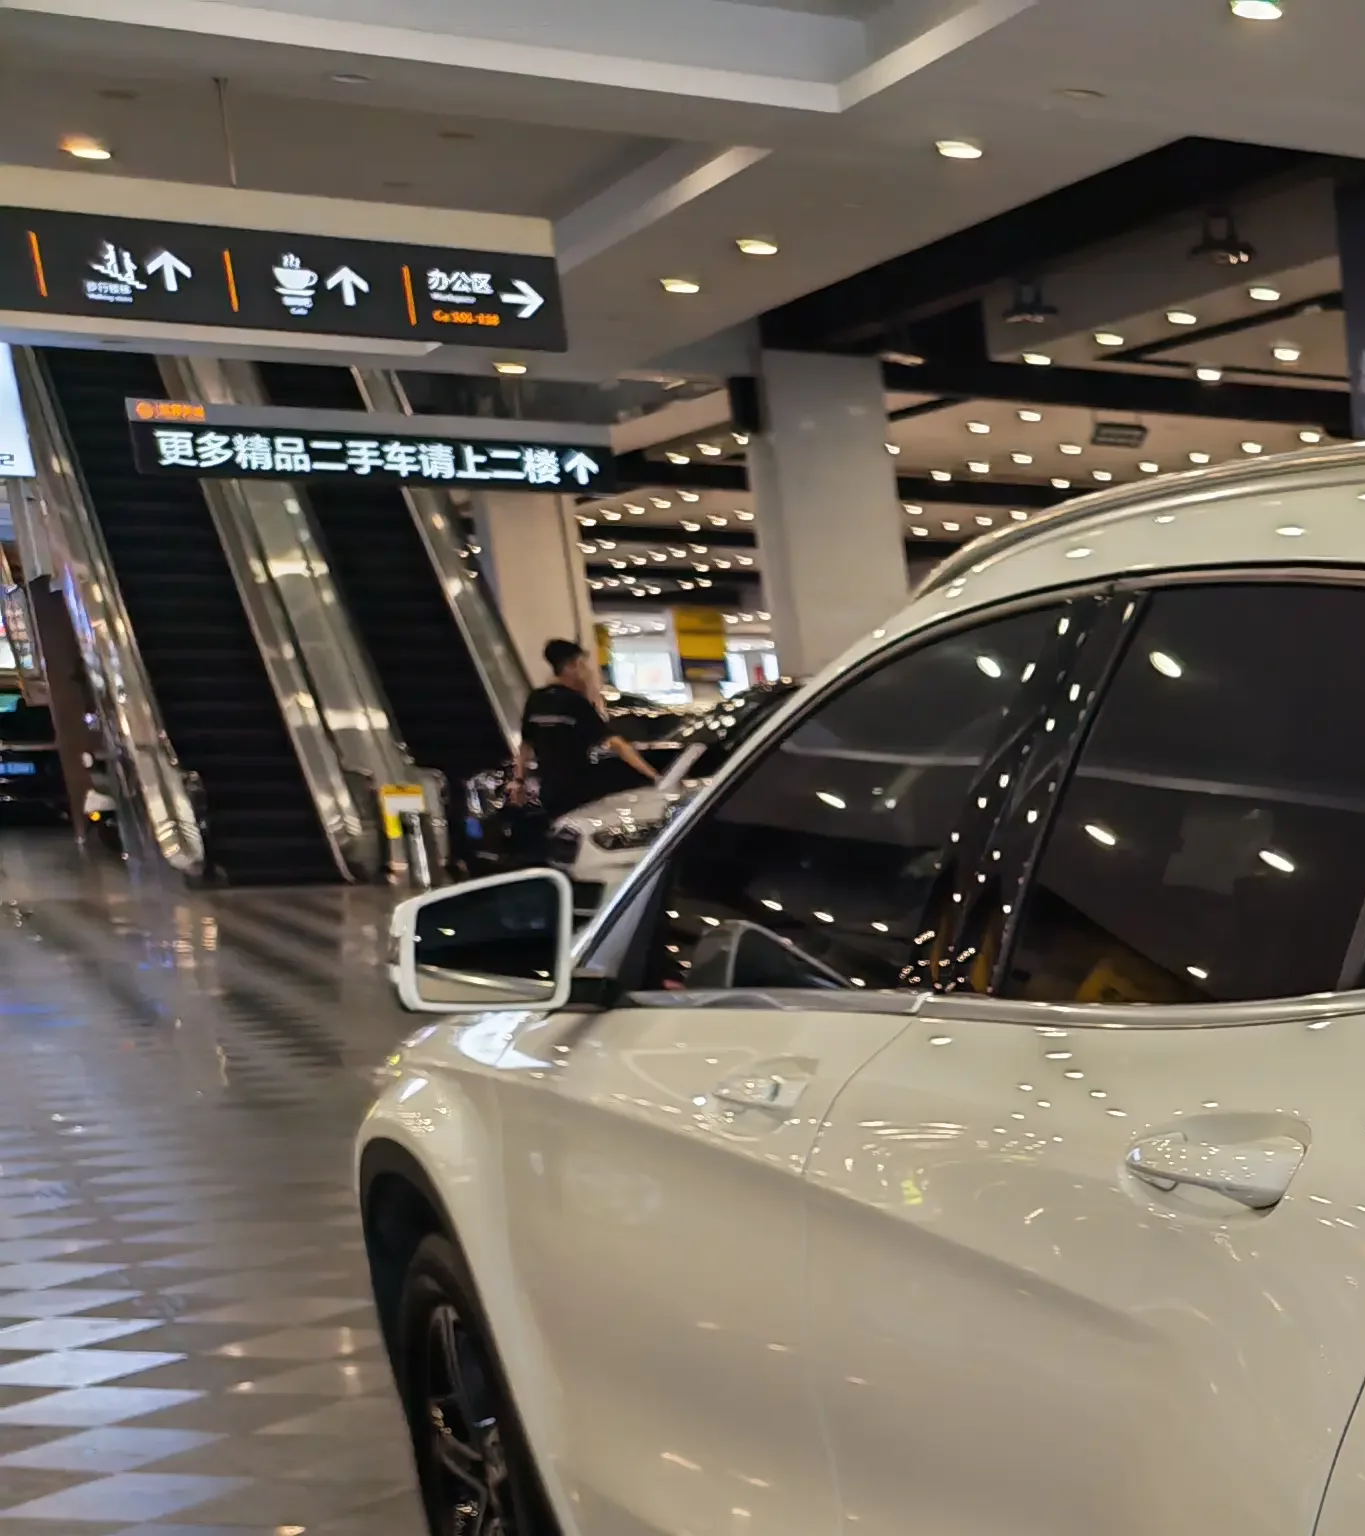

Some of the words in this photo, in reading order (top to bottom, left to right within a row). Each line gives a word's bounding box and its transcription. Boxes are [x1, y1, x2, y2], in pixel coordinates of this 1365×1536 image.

[427, 268, 494, 294] 办公区
[153, 430, 561, 484] 更多精品二手车请上二楼
